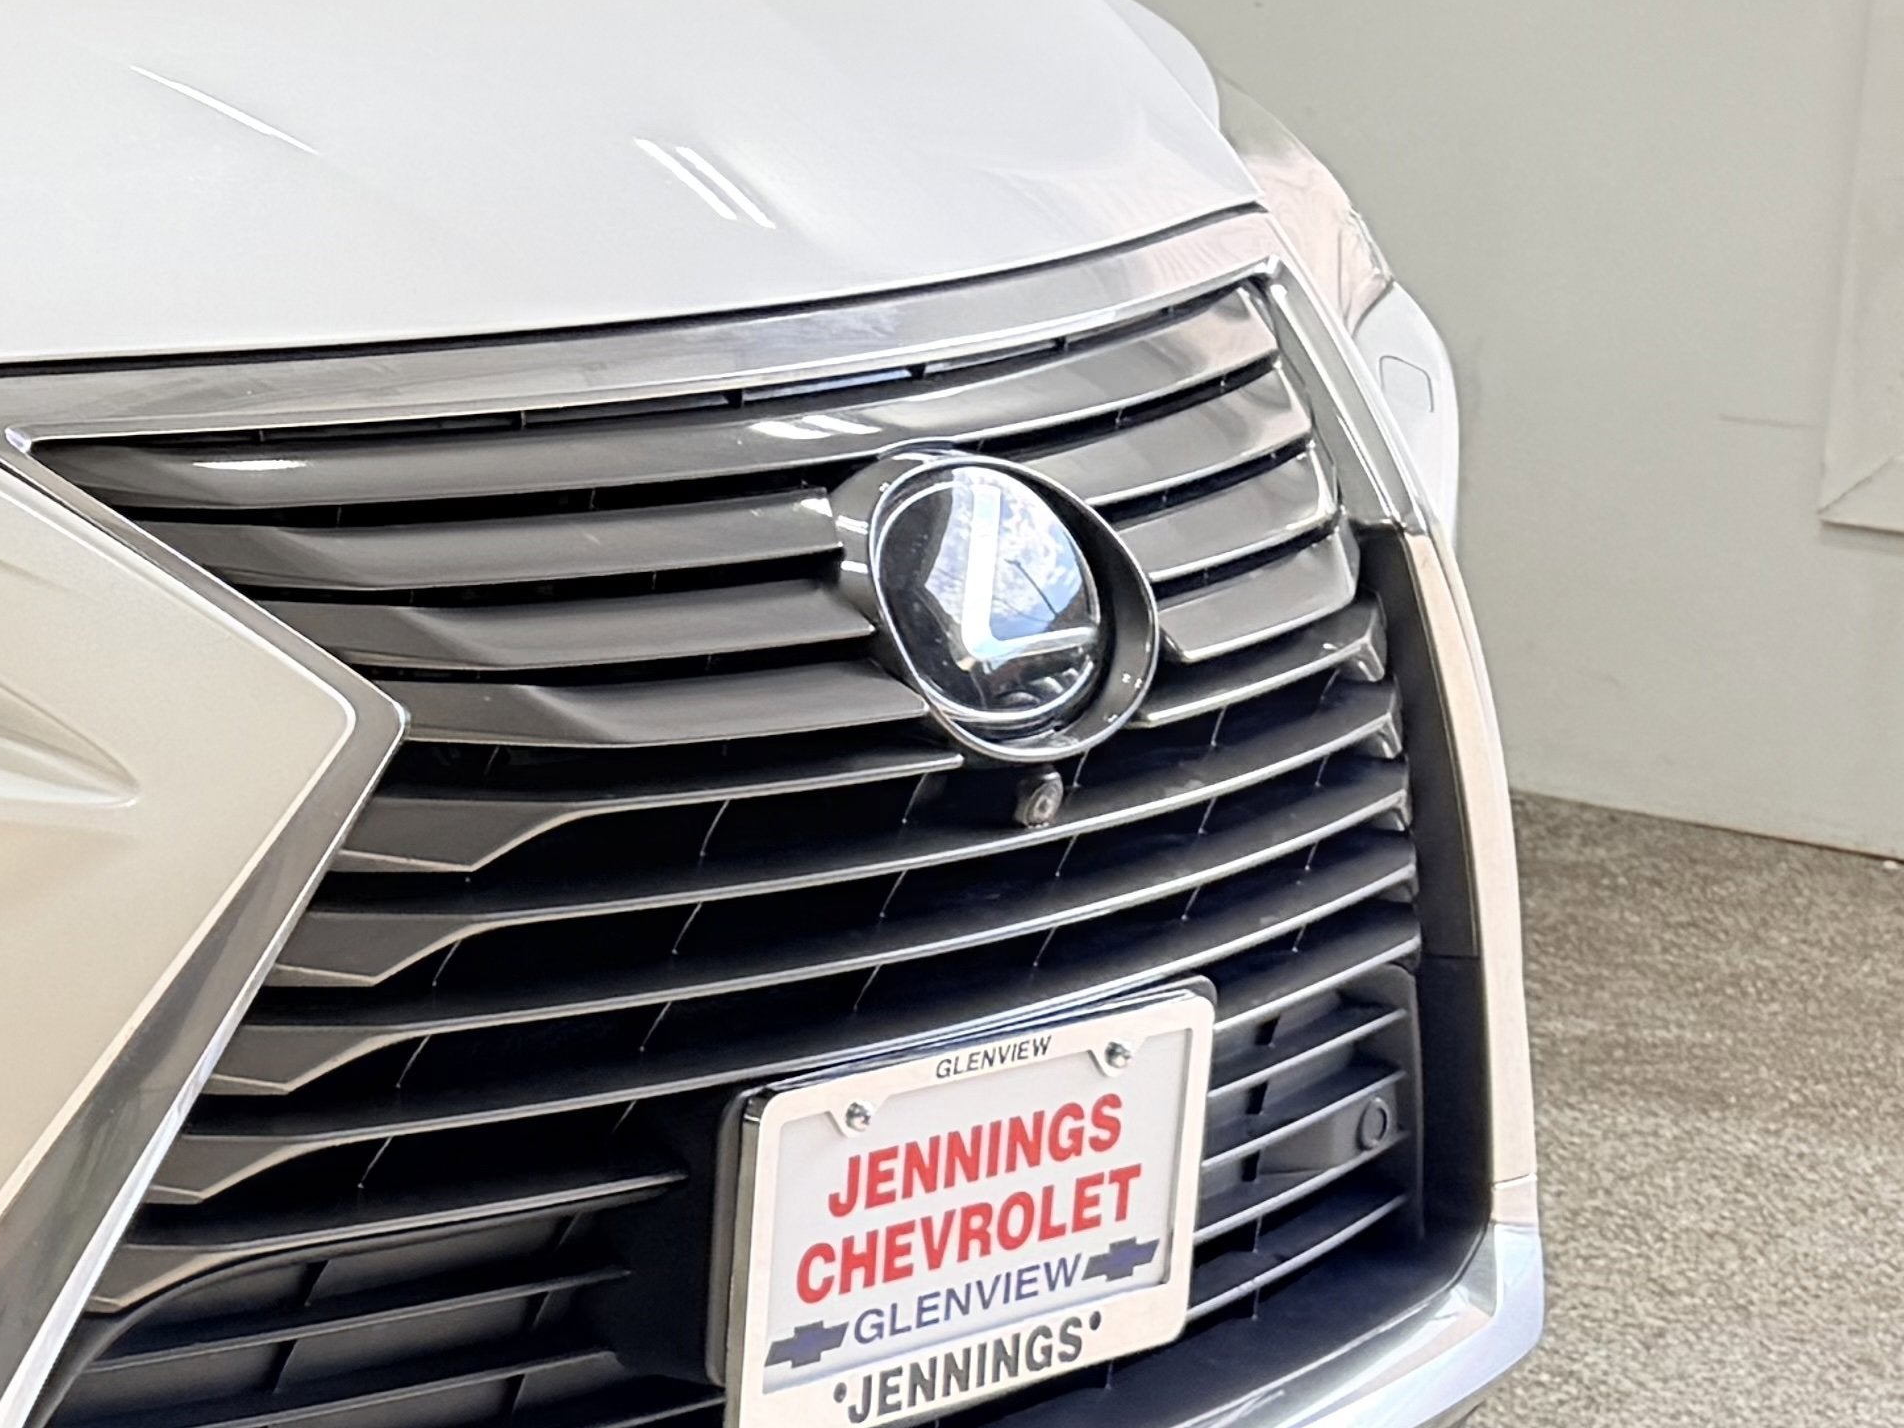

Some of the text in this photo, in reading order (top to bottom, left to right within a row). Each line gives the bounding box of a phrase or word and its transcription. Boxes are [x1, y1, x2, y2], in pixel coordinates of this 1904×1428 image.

[935, 1035, 1052, 1080] GLENVIEW
[828, 1093, 1123, 1219] JENNINGS
[795, 1163, 1143, 1305] CHEVROLET
[853, 1254, 1082, 1345] GLENVIEW
